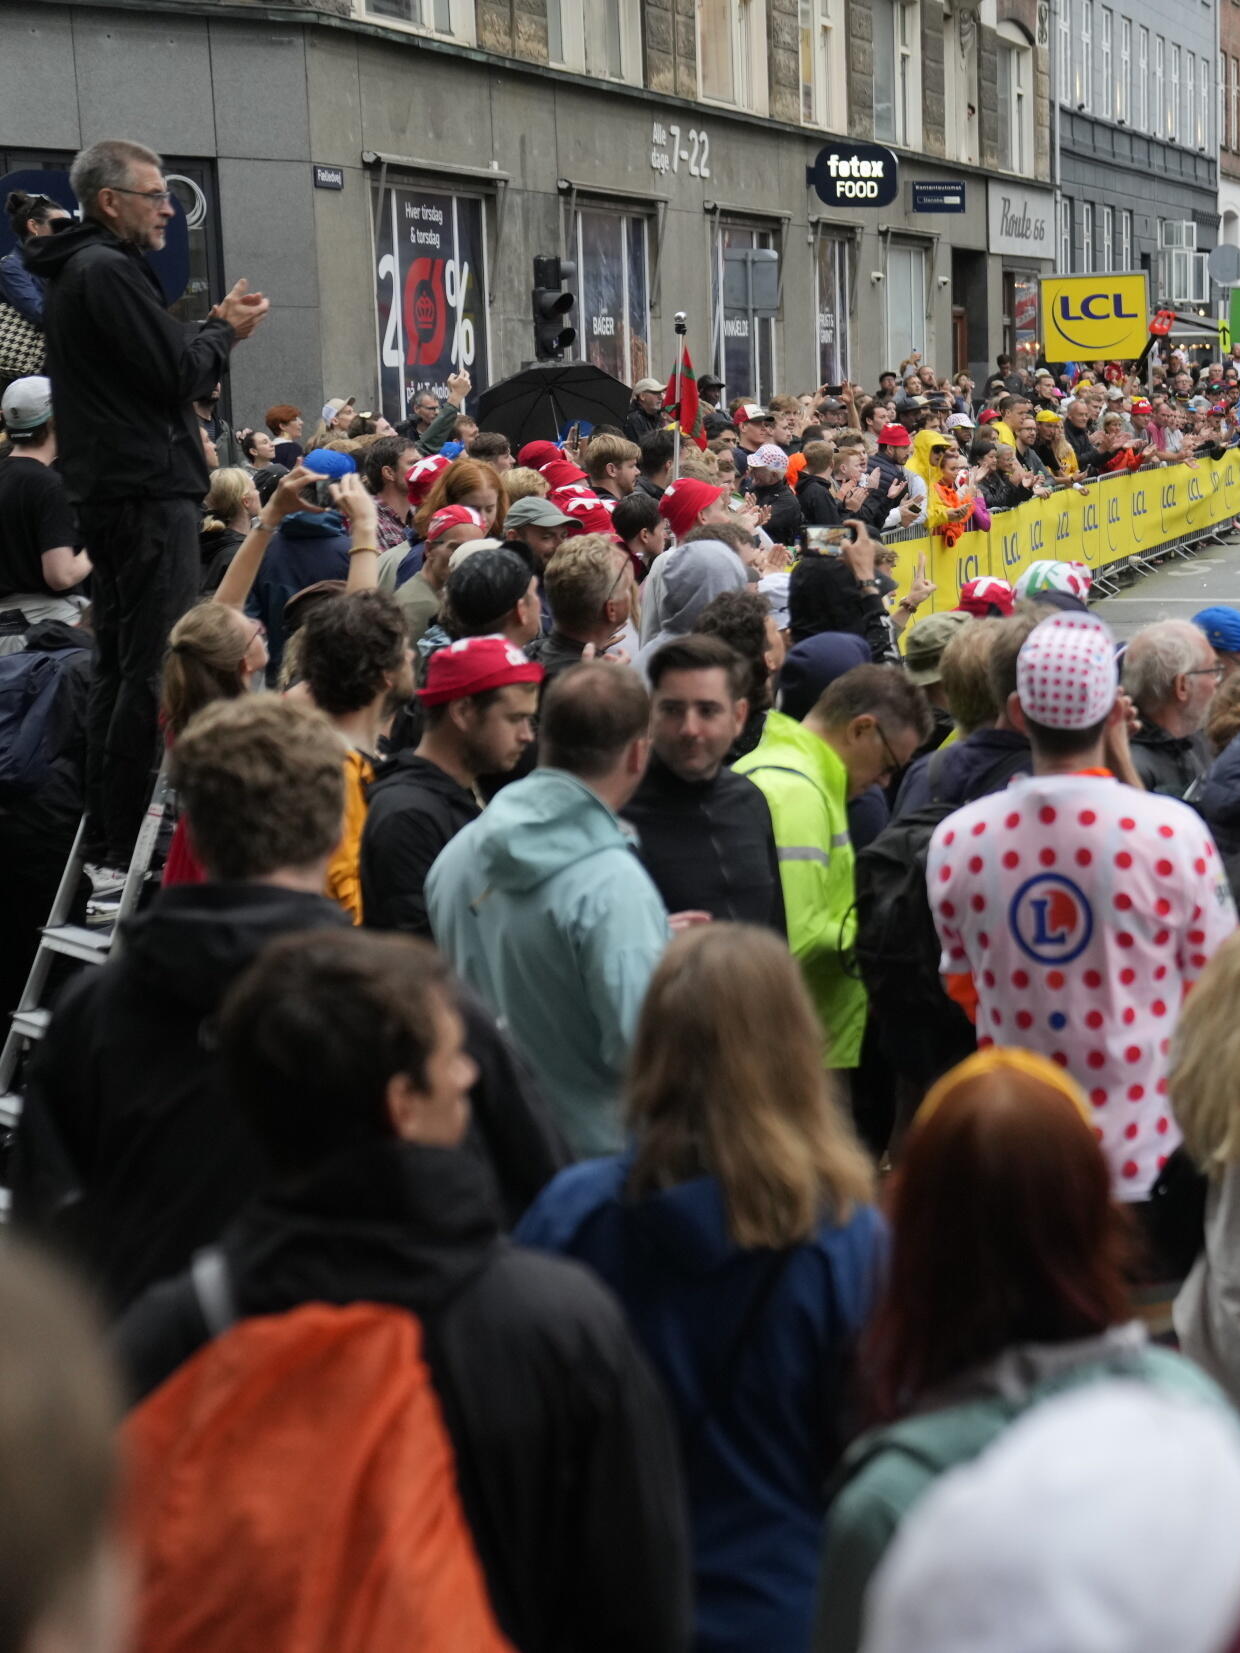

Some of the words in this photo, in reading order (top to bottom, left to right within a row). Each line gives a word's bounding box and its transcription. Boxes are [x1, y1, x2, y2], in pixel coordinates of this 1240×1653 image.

[652, 122, 667, 146] Alle
[652, 148, 669, 174] dage
[670, 126, 710, 178] 7-22
[836, 181, 878, 198] FOOD
[405, 202, 420, 219] Hver
[422, 204, 444, 226] tirsdag
[1001, 197, 1032, 240] Route
[1034, 219, 1045, 241] 66
[410, 226, 416, 244] &
[417, 229, 440, 249] torsdag
[1060, 293, 1138, 320] LCL
[592, 316, 614, 336] BAGER
[1002, 533, 1020, 565] LCL
[1030, 520, 1044, 551] LCL
[1056, 512, 1070, 540] LCL
[1083, 504, 1098, 532] LCL
[1108, 496, 1120, 524] LCL
[1132, 490, 1148, 516] LCL
[1162, 484, 1176, 508] LCL
[1188, 477, 1204, 501] LCL
